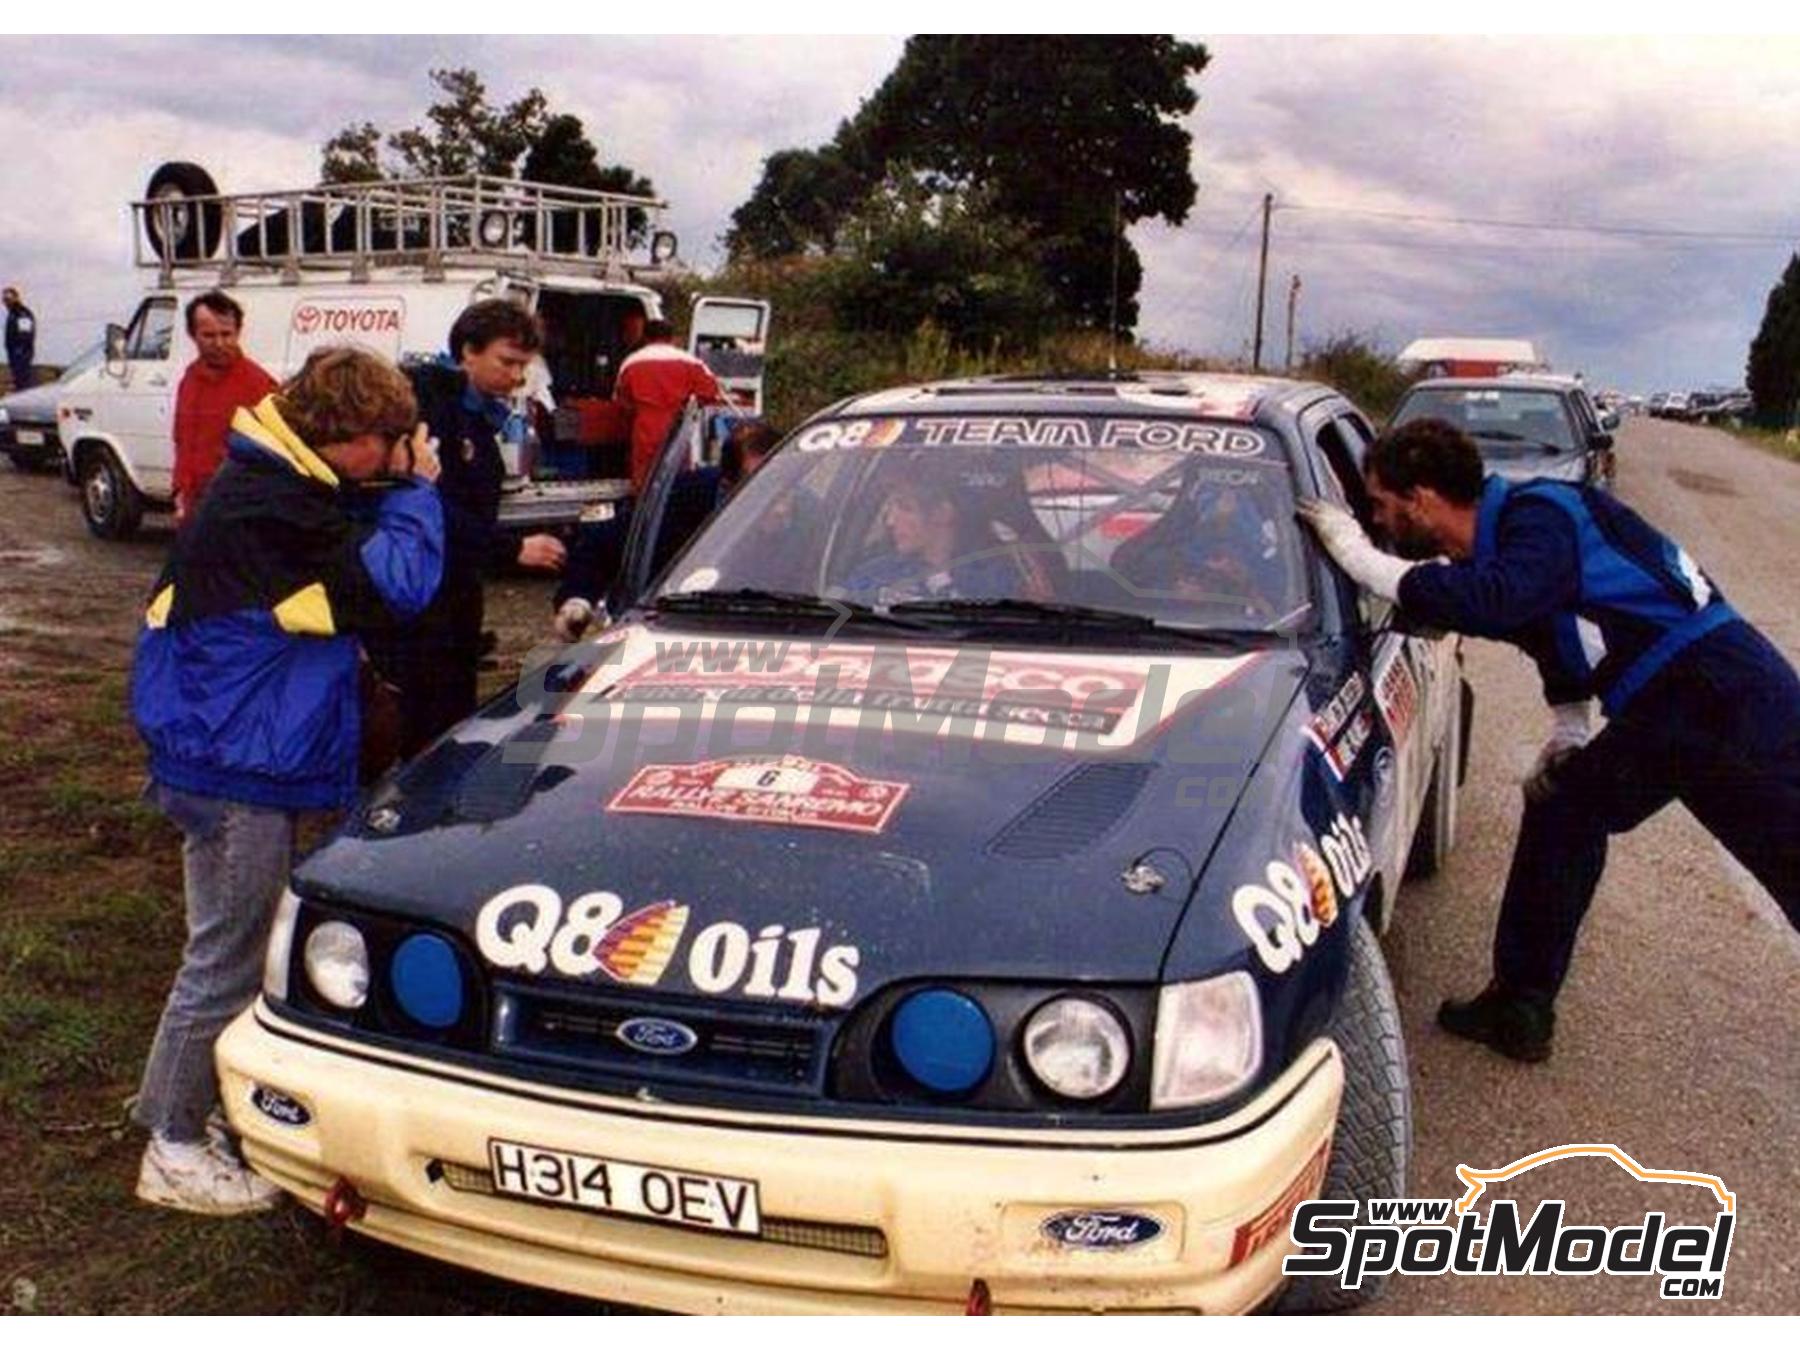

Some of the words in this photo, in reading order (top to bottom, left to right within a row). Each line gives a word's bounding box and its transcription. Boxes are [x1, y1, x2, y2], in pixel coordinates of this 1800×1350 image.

[322, 308, 399, 332] TOYOTA
[799, 421, 872, 451] Q8
[916, 418, 1091, 447] TEAM
[1100, 421, 1266, 455] FORD
[475, 883, 623, 976] Q8
[688, 920, 860, 1006] Oils
[1231, 859, 1321, 975] Q8
[495, 1145, 613, 1207] H314
[640, 1171, 748, 1228] OEV
[1064, 1212, 1139, 1242] Ford
